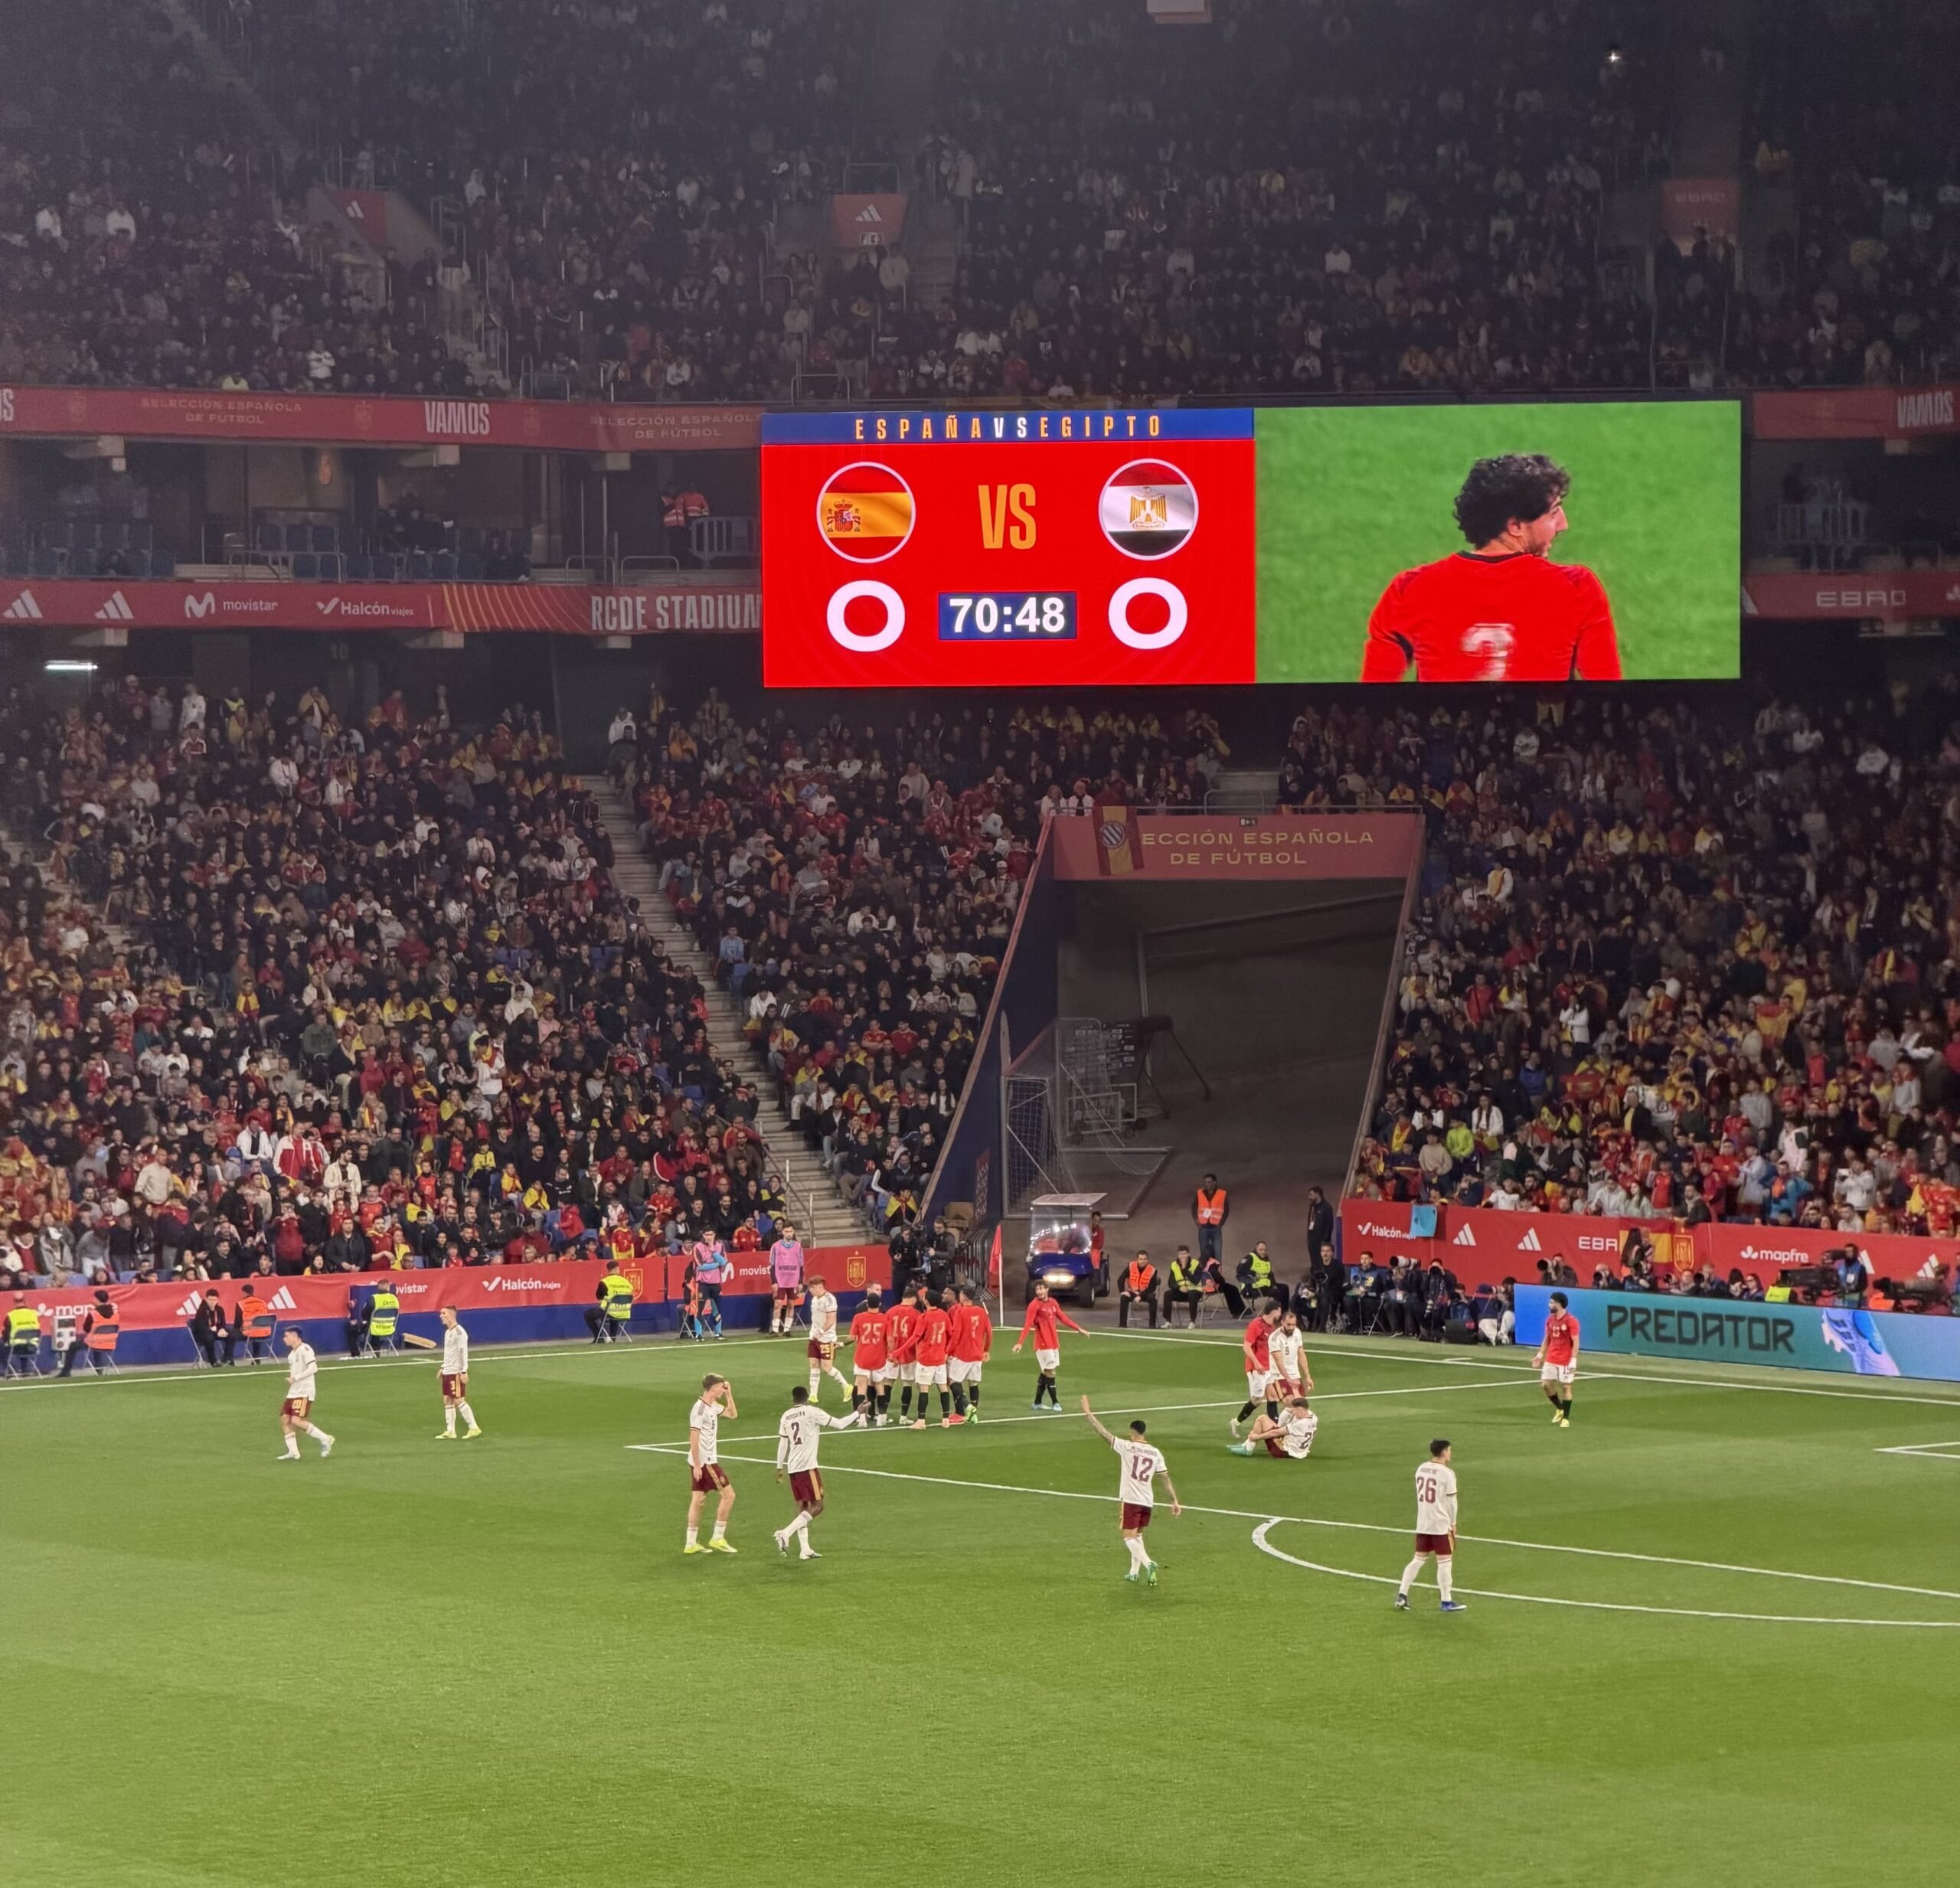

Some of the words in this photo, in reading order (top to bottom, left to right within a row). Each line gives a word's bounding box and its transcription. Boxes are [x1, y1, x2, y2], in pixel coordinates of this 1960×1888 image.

[185, 412, 204, 423] DE
[424, 400, 490, 436] VAMOS
[681, 411, 760, 425] ESPAÑOL
[1897, 390, 1955, 430] VAMOS
[635, 430, 655, 439] DE
[855, 415, 982, 440] ESPAÑA
[994, 416, 1027, 439] VS
[1040, 414, 1161, 439] EGIPTO
[978, 482, 1037, 550] VS
[223, 599, 278, 611] movistar
[341, 600, 390, 616] Halcón
[390, 607, 413, 617] viajes
[591, 596, 648, 631] RCDE
[948, 596, 1067, 634] 70:48
[1142, 829, 1233, 845] ECCIÓN
[1243, 828, 1374, 844] ESPAÑOLA
[1170, 853, 1200, 865] DE
[1211, 849, 1307, 865] FÚTBOL
[1371, 1225, 1402, 1239] Halcón
[1578, 1236, 1618, 1252] EBR
[1760, 1248, 1809, 1264] mapfre
[739, 1265, 771, 1276] movist
[396, 1283, 428, 1295] vistar
[501, 1277, 542, 1292] Halcón
[542, 1281, 561, 1290] viajes
[861, 1322, 882, 1344] 25
[970, 1315, 979, 1338] 7
[1606, 1304, 1795, 1354] PREDATOR
[820, 1344, 831, 1354] 25
[791, 1422, 802, 1445] 2
[1131, 1455, 1153, 1483] 12
[1416, 1476, 1437, 1504] 26
